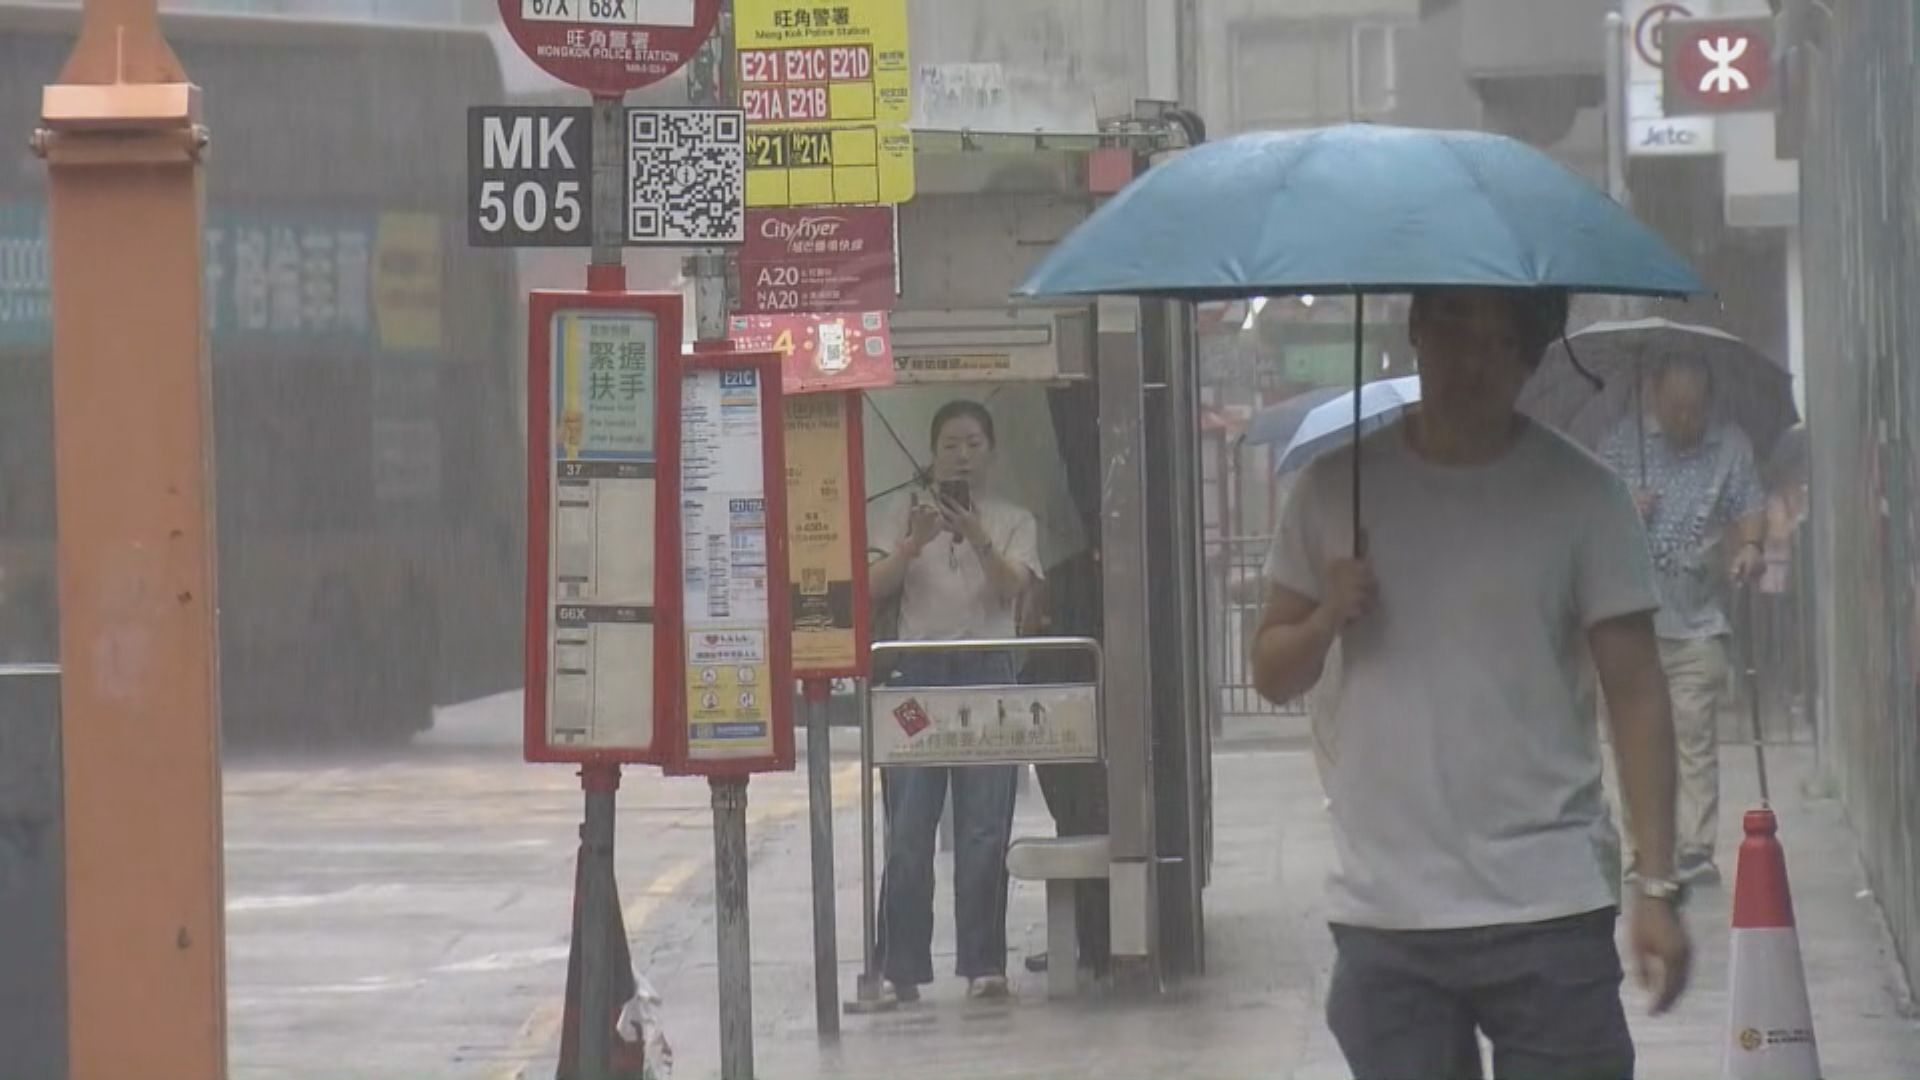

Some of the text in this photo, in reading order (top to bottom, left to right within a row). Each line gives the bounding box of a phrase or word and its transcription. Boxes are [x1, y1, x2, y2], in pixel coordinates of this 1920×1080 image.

[533, 0, 568, 16] 67X
[589, 0, 626, 18] 68X
[774, 7, 849, 28] 旺角警署
[567, 30, 649, 49] 旺角警署
[755, 27, 870, 40] Mong Kok Police Station
[537, 45, 679, 62] MONGKOK POLICE STATION
[741, 52, 778, 82] E21
[785, 50, 826, 79] E21C
[830, 48, 869, 77] E21D
[743, 88, 826, 119] E21A E21B
[482, 117, 576, 169] MK
[478, 181, 581, 232] 505
[757, 267, 799, 286] A20
[590, 342, 646, 370] 緊握
[590, 372, 646, 400] 扶手
[725, 371, 752, 385] E21C
[566, 464, 582, 476] 37
[560, 608, 586, 620] 66X
